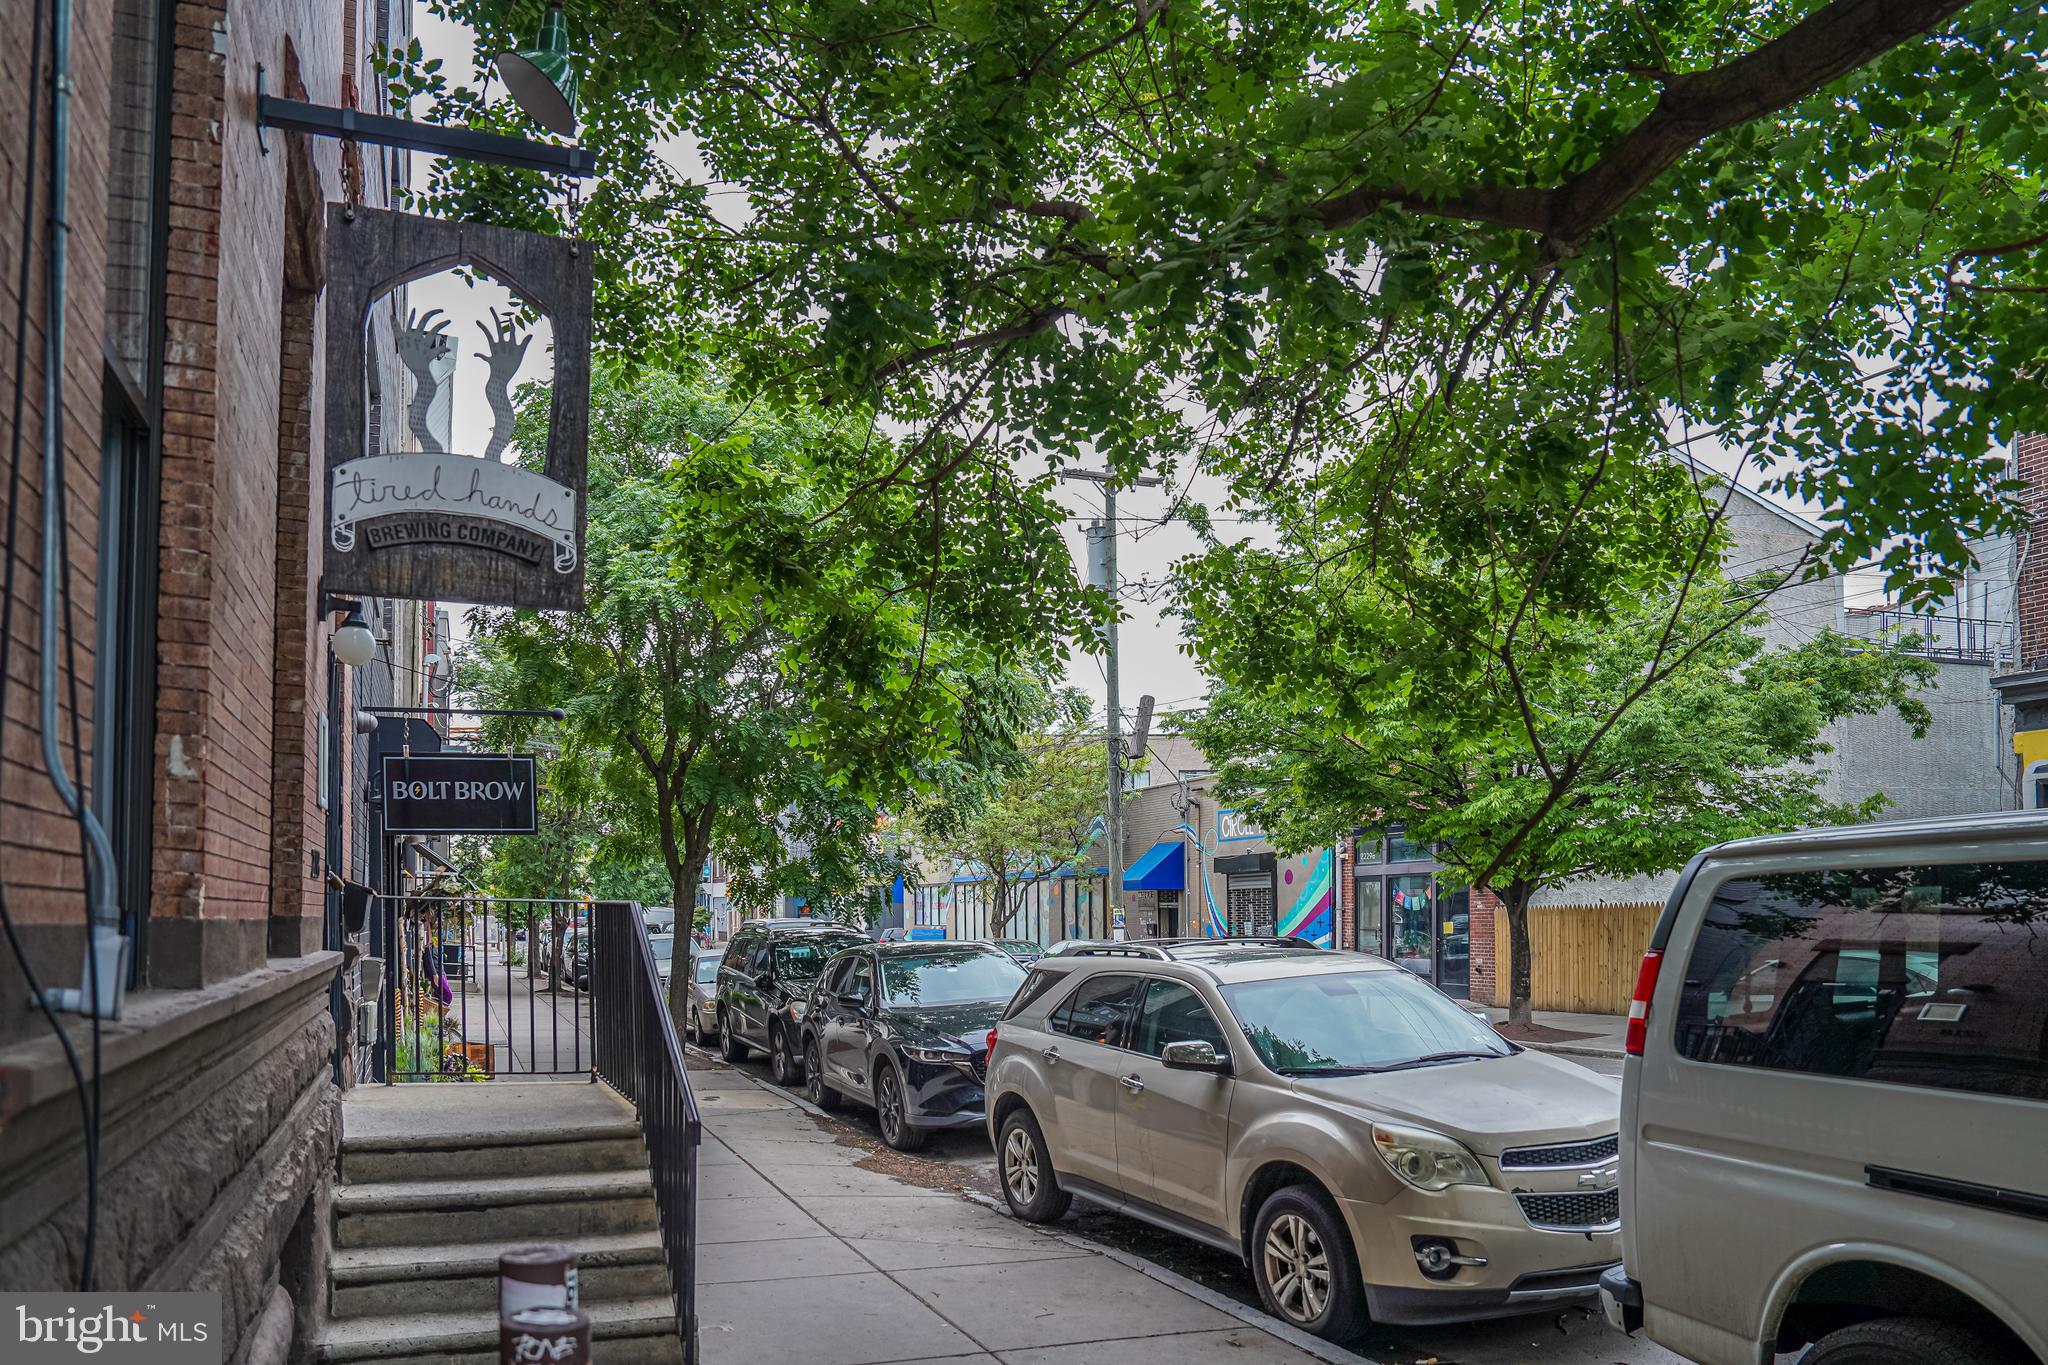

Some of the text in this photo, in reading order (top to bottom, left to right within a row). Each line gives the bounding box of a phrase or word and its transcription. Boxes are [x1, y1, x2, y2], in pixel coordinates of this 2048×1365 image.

[336, 465, 575, 533] tired hands
[370, 522, 543, 559] BREWING COMPANY
[392, 780, 526, 801] BOLT BROW
